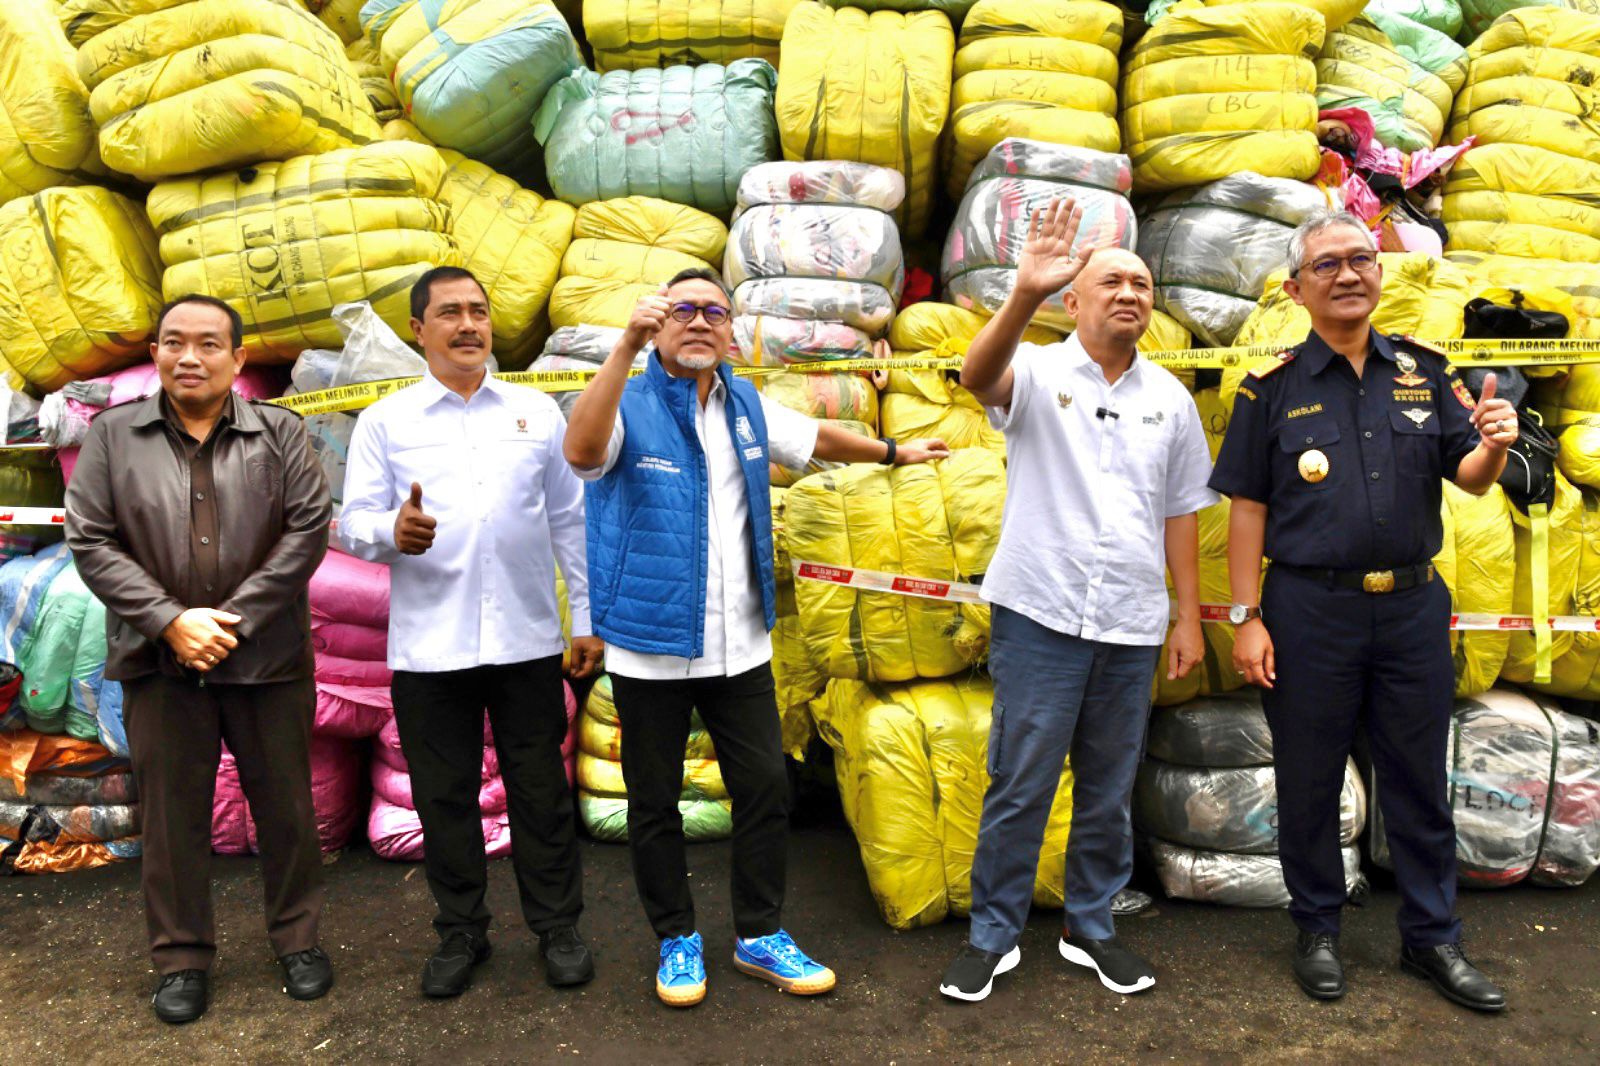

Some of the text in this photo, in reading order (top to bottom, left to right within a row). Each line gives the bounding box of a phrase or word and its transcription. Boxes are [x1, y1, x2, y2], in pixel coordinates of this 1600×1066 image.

[1501, 340, 1556, 352] DILARANG
[1147, 351, 1178, 361] GARIS
[1181, 349, 1215, 360] POLISI
[537, 371, 579, 383] MELINTAS
[325, 384, 371, 400] MELINTAS
[1287, 403, 1323, 419] ASKOLANI
